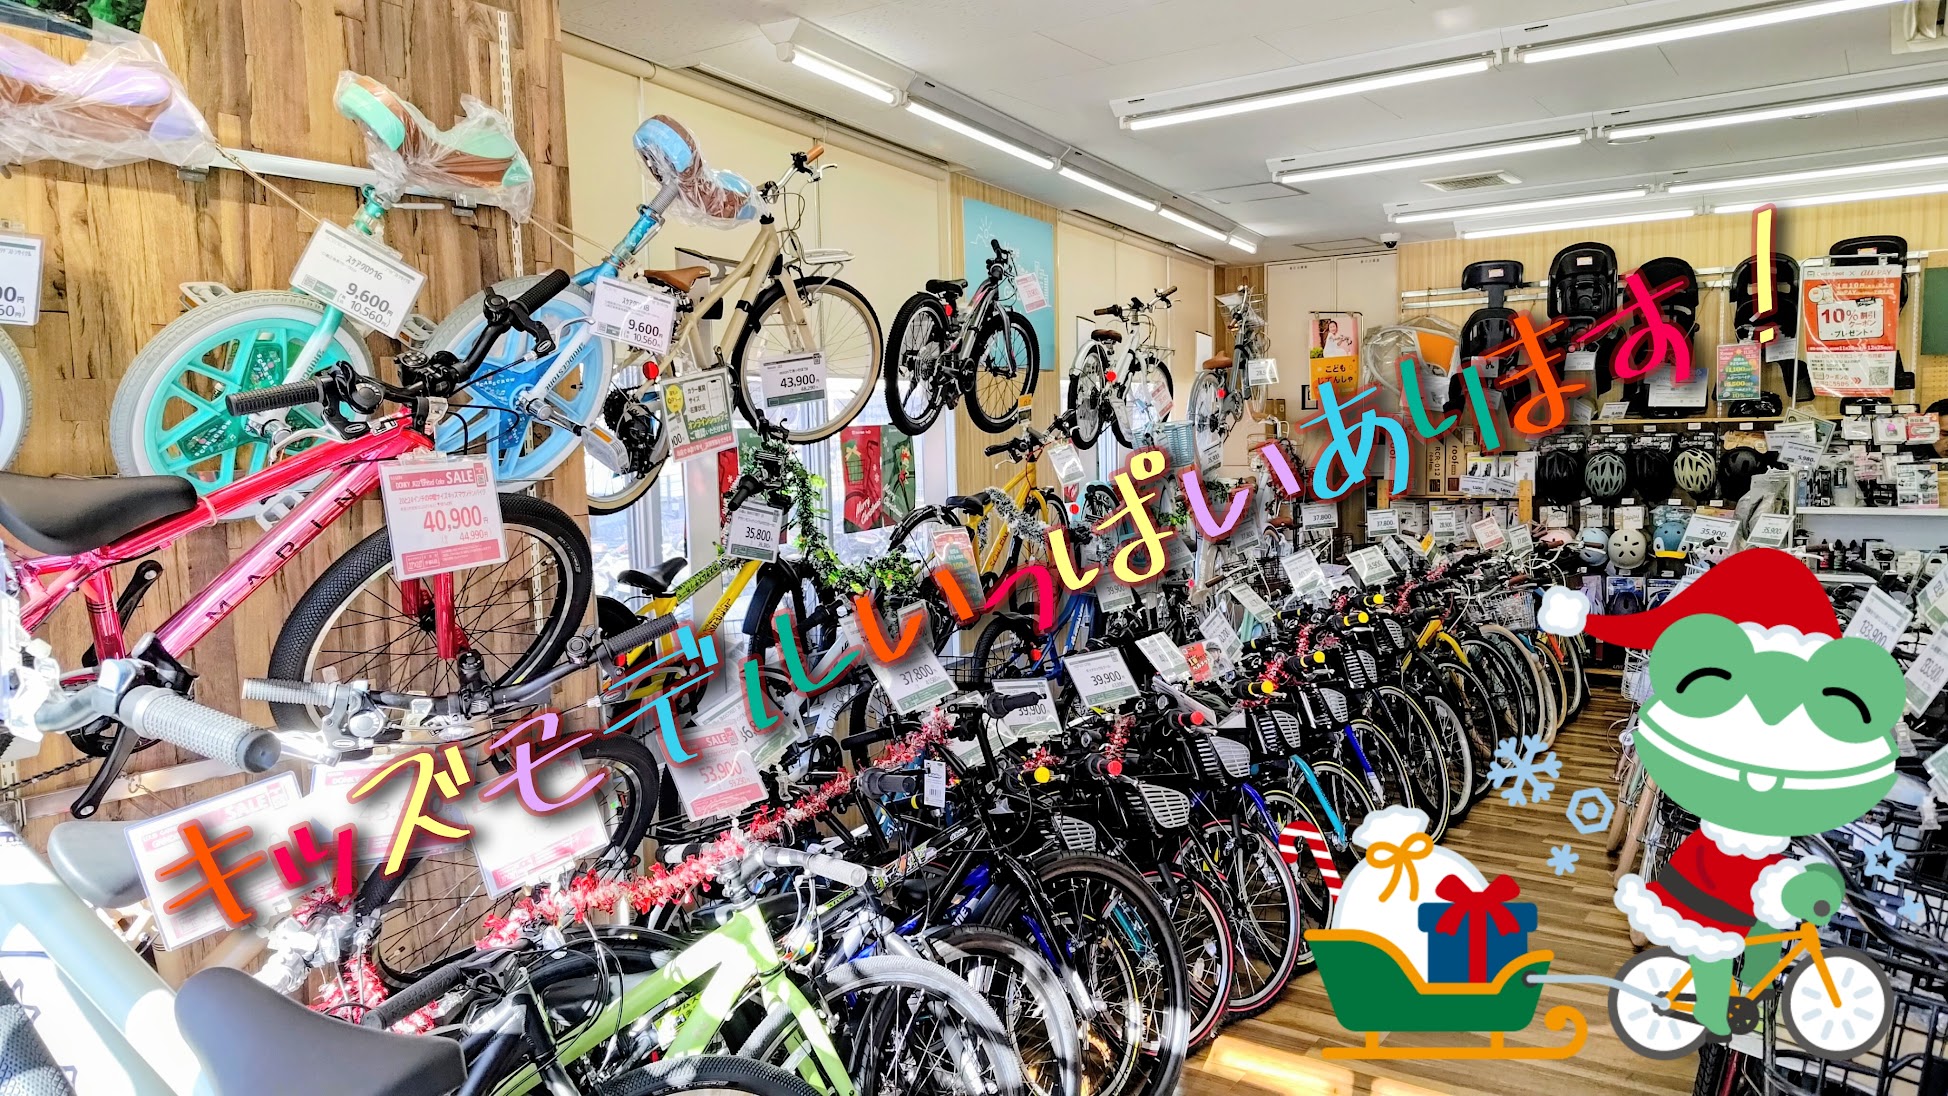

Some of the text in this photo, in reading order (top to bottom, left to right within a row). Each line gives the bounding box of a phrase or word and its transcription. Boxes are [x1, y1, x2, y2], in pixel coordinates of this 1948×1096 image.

[1325, 364, 1346, 373] こども
[446, 470, 475, 485] SALE
[205, 488, 357, 621] MARIN
[706, 733, 728, 747] SALE
[223, 791, 272, 822] SALE
